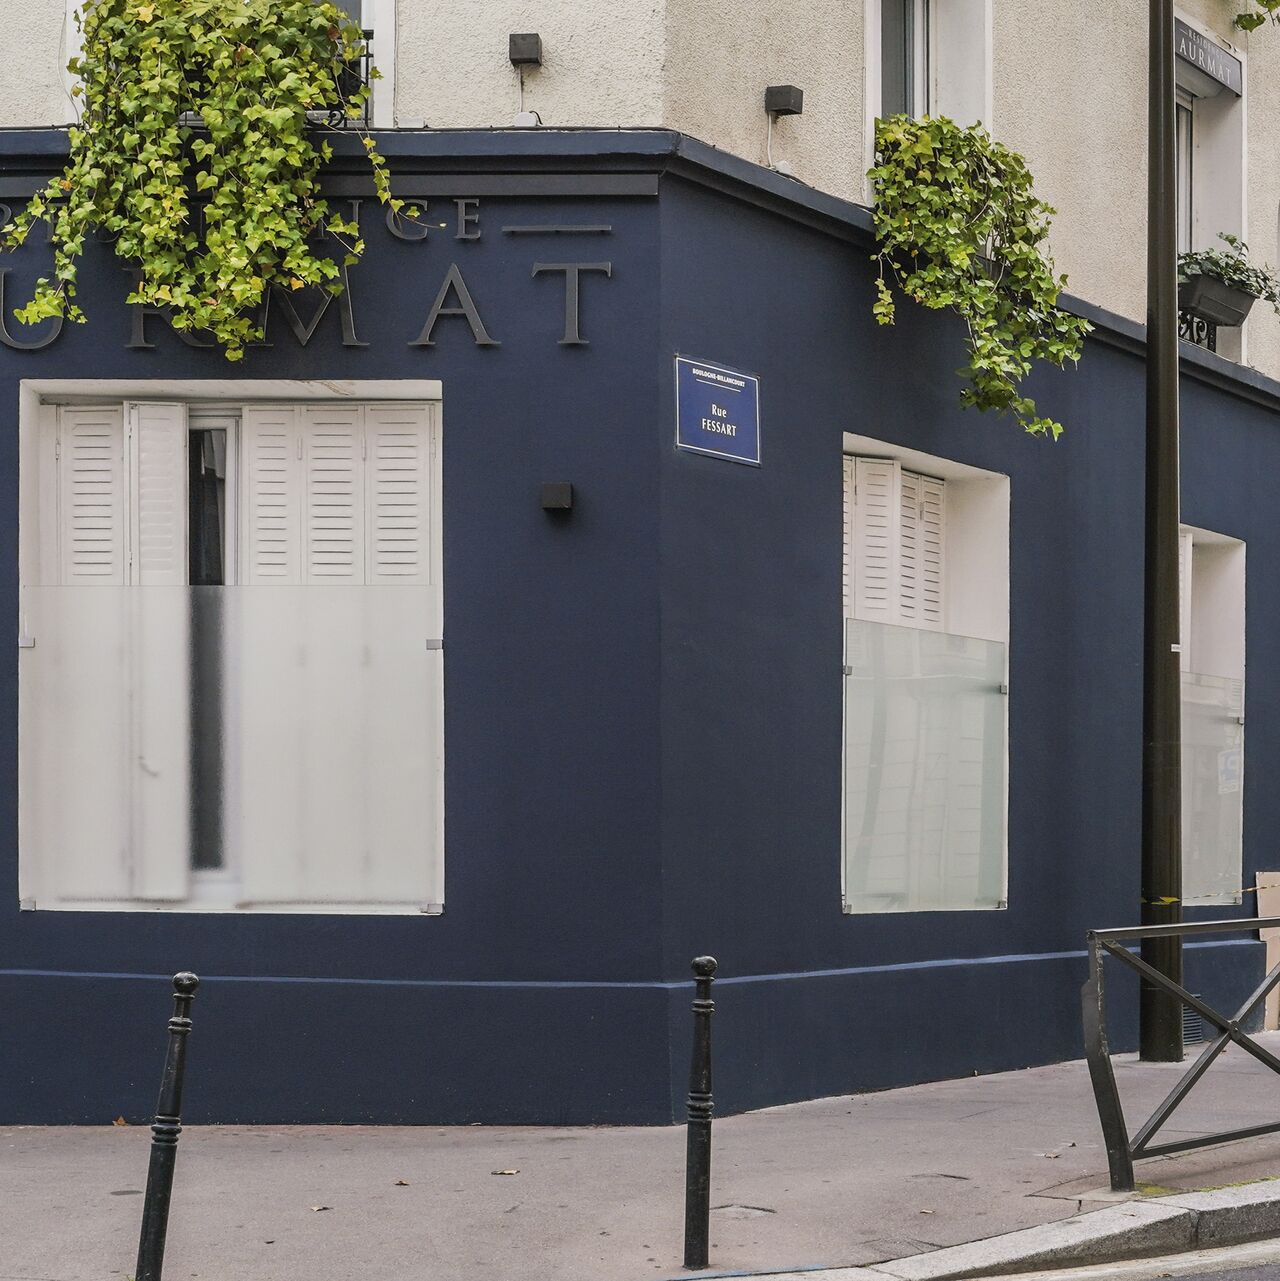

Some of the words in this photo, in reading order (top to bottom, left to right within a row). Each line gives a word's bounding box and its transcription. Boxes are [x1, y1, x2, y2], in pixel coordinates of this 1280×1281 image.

[1180, 37, 1232, 85] AURMAT
[692, 368, 745, 388] BOULOGNE-BILLANCOURT
[711, 404, 727, 418] Rue
[702, 418, 737, 437] FESSART
